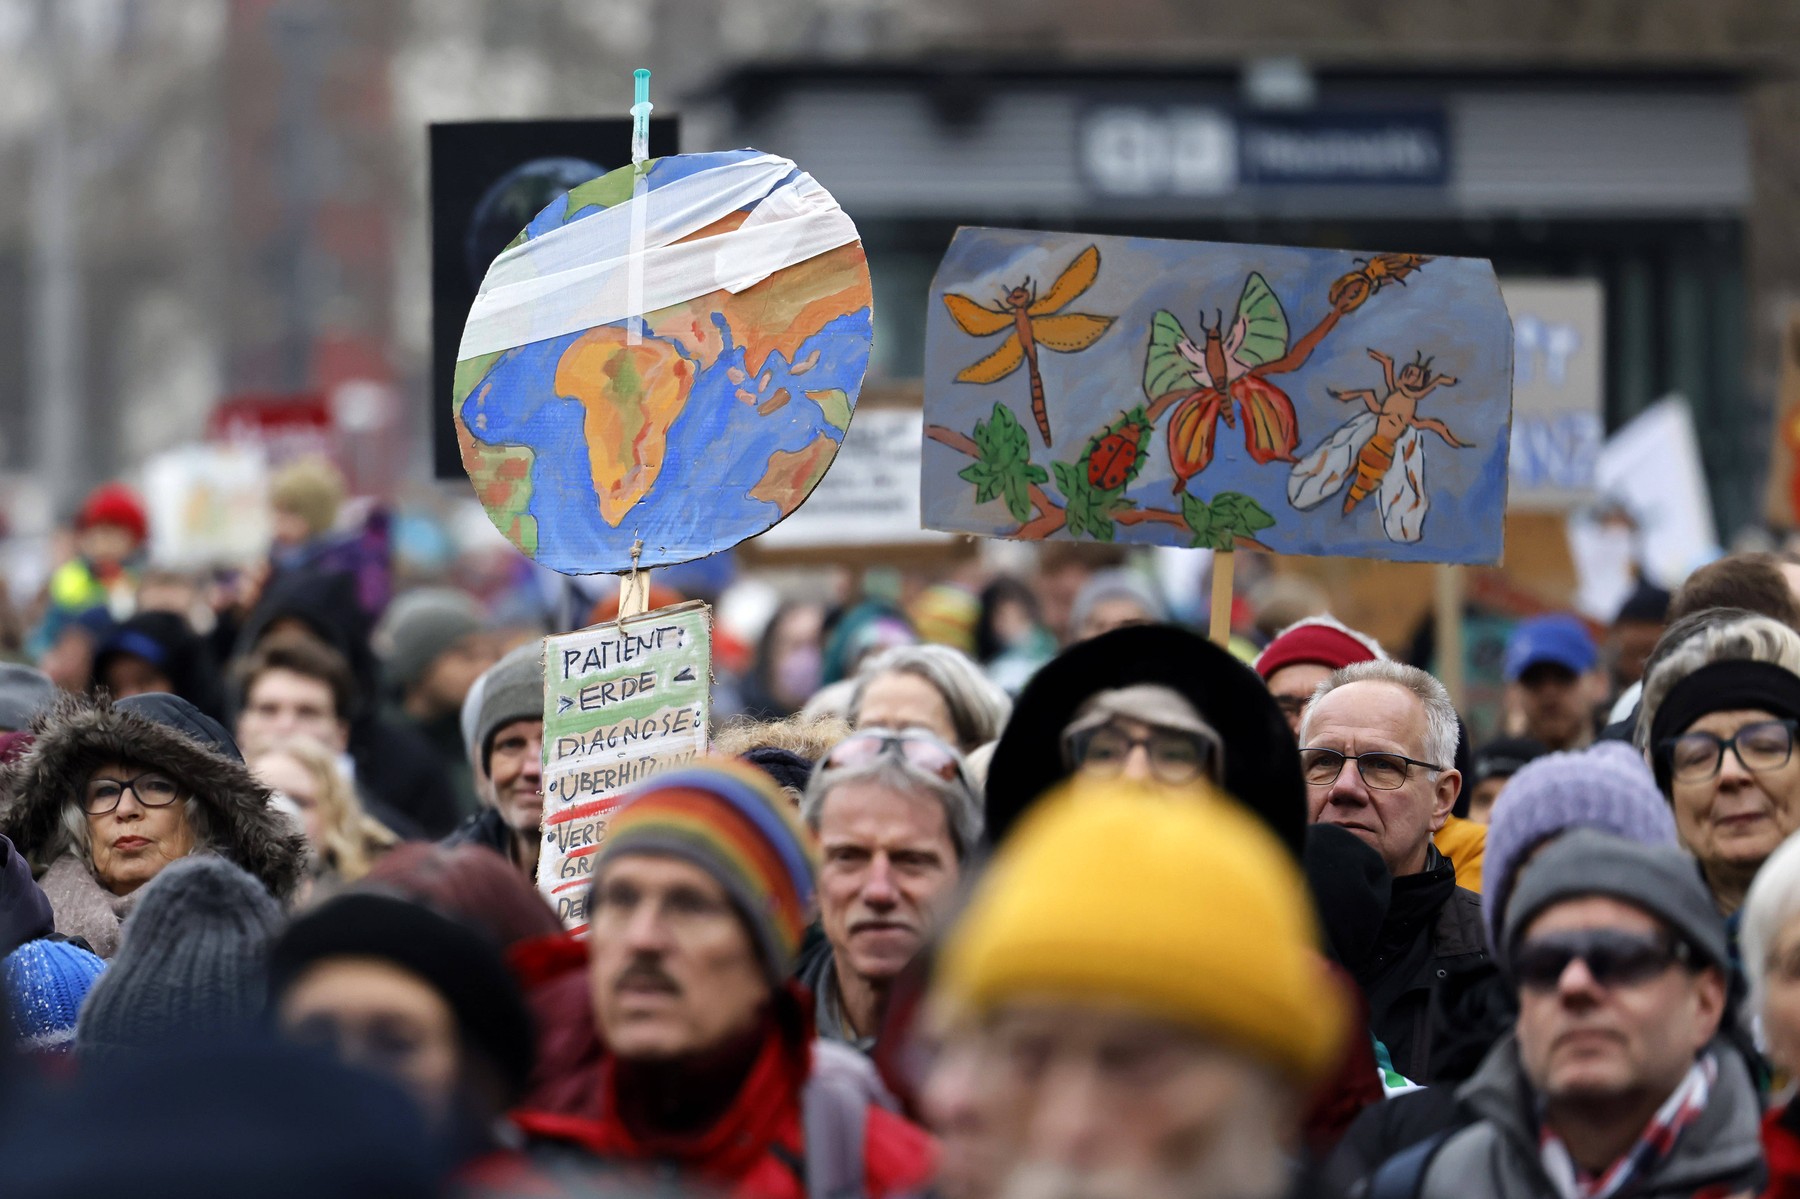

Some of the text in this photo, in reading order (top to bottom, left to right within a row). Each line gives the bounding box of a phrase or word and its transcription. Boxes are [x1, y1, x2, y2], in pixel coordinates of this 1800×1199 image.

[563, 626, 685, 679] PATIENT:
[579, 671, 656, 711] ERDE
[557, 708, 701, 760] DIAGNOSE:
[559, 749, 697, 801] ÜBERHITZUN
[557, 813, 608, 853] VERB
